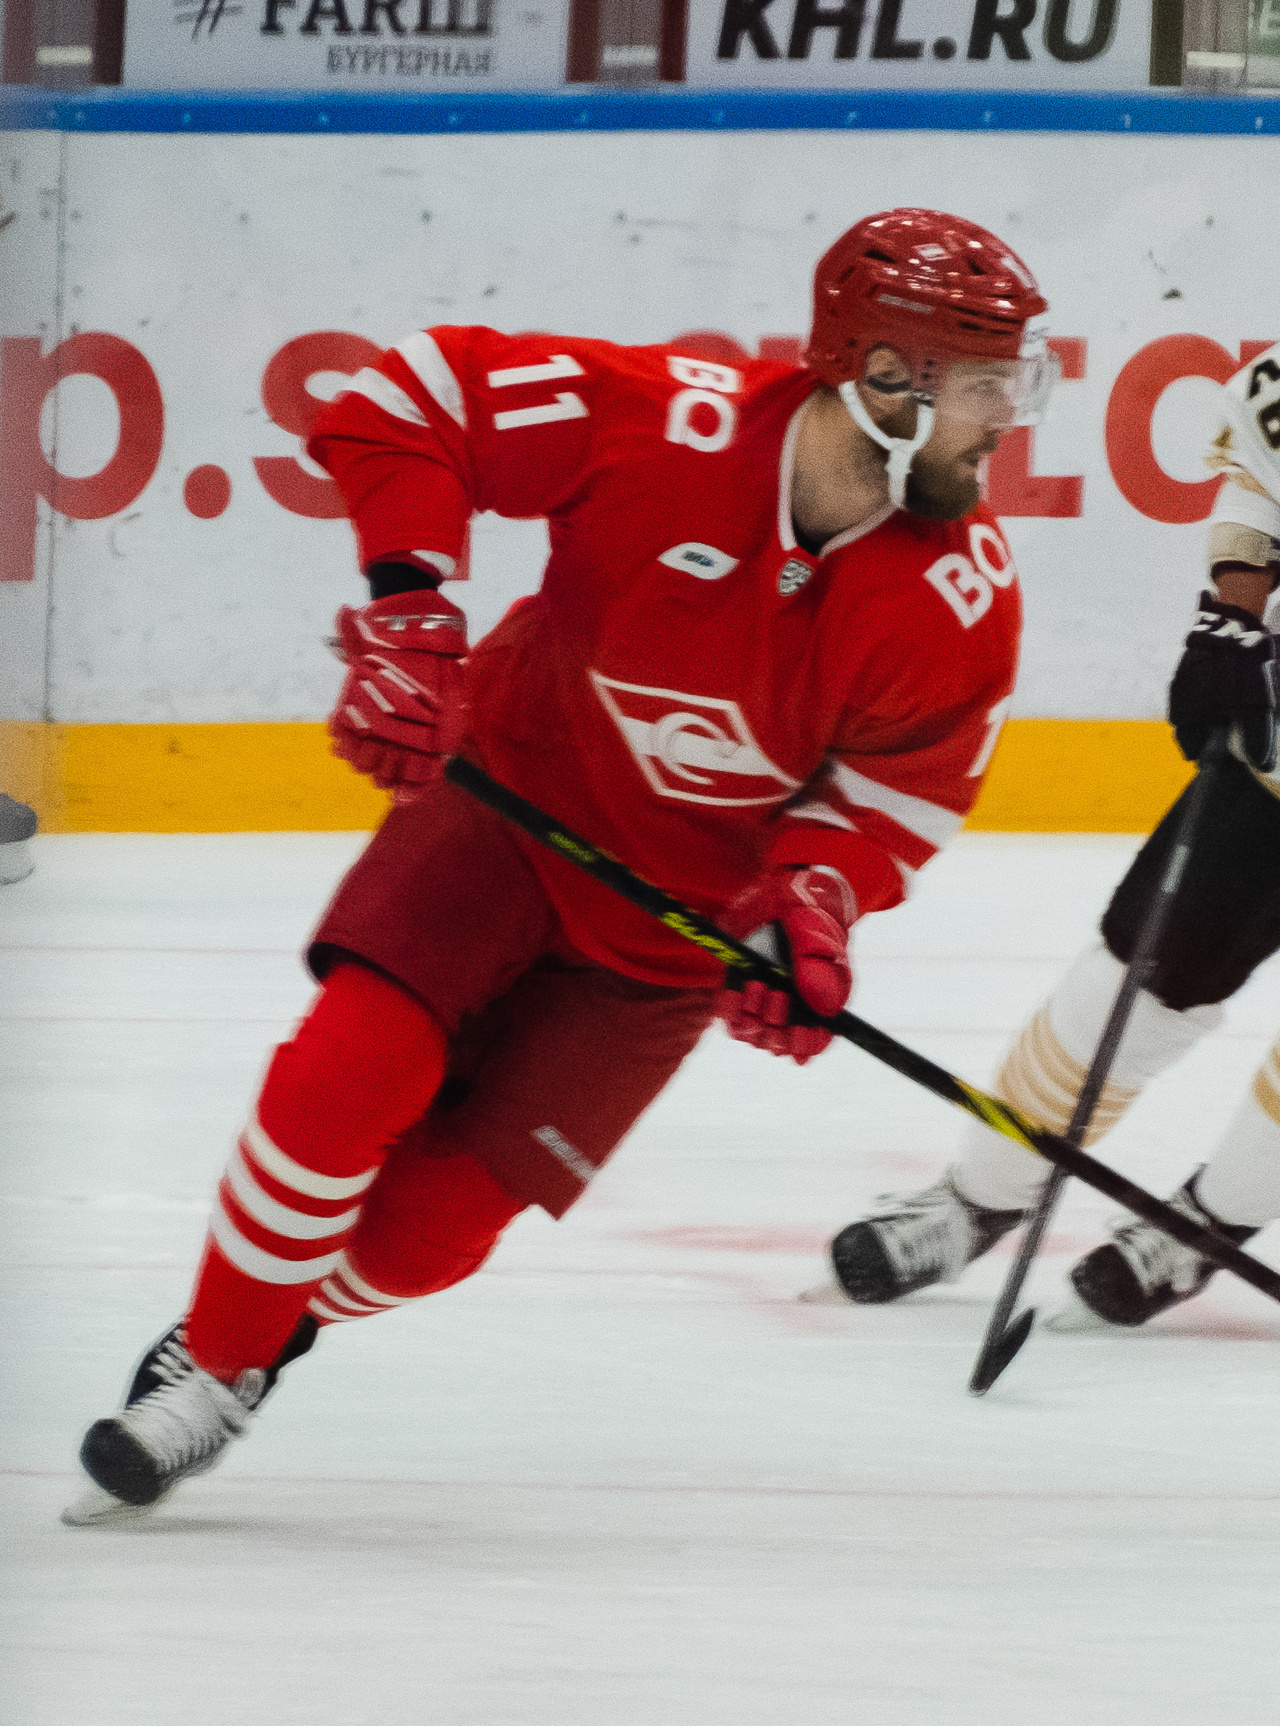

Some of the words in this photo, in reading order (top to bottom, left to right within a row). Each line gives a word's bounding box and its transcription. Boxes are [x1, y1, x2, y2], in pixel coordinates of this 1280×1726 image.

[326, 44, 492, 76] БУРГЕРНАЯ
[716, 0, 1119, 62] KHL.RU
[487, 354, 590, 431] 11
